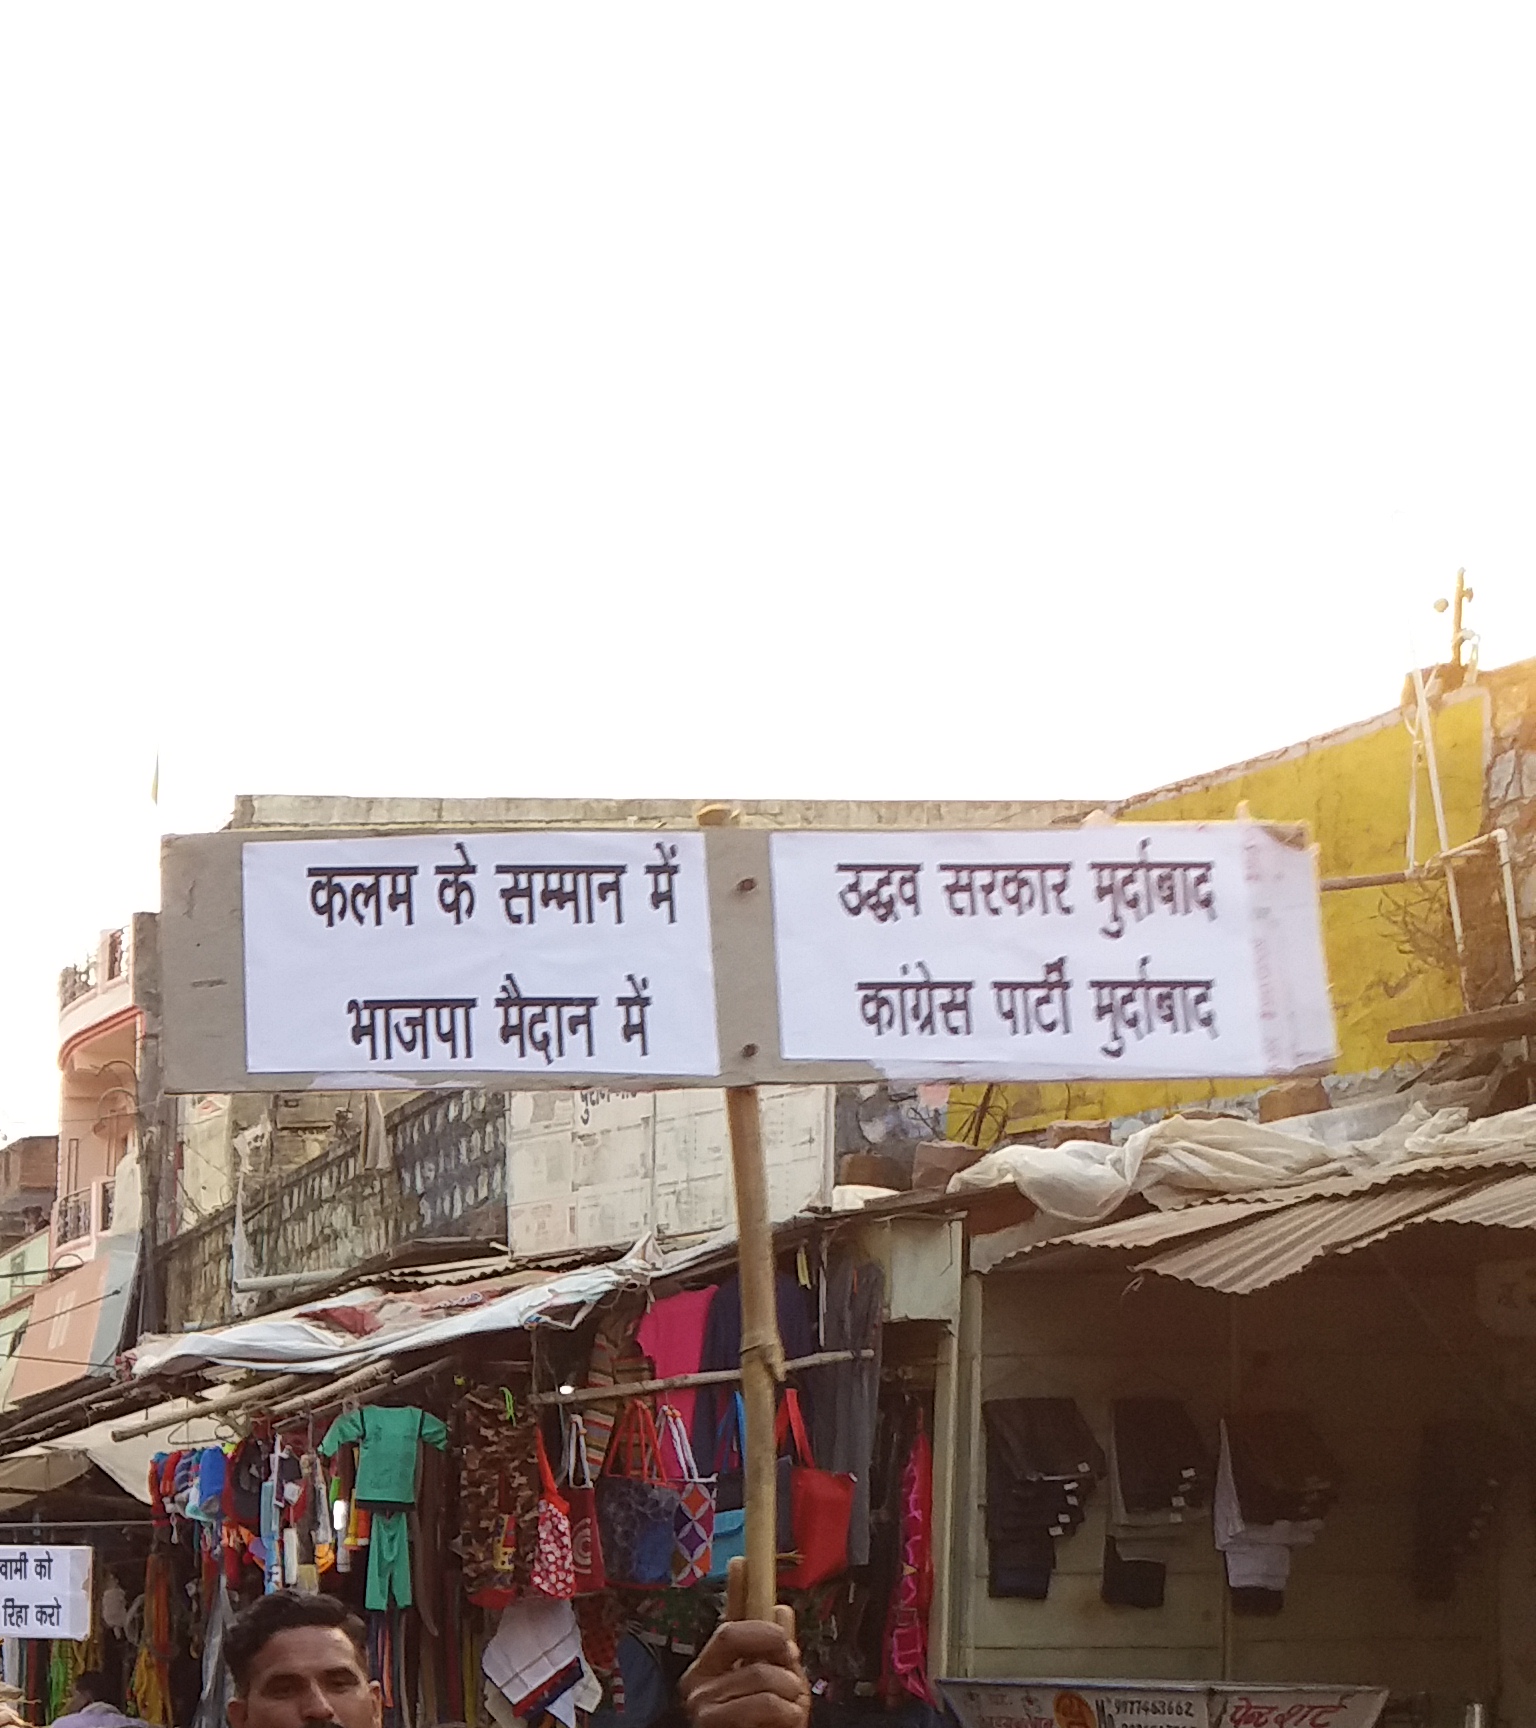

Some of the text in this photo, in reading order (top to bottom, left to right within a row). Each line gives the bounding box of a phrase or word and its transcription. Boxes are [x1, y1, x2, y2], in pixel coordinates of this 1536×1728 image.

[307, 842, 679, 927] कलम के सम्मान में
[837, 864, 921, 923] उद्धव
[939, 862, 1073, 916] सरकार
[1089, 839, 1217, 939] मुर्दाबाद
[348, 973, 651, 1065] भाजपा मैदान में
[857, 962, 974, 1035] कांग्रेस
[991, 957, 1071, 1035] पार्टी
[1089, 957, 1213, 1058] मुर्दाबाद
[34, 1551, 53, 1580] को
[2, 1598, 29, 1627] रिहा
[34, 1597, 62, 1626] करो
